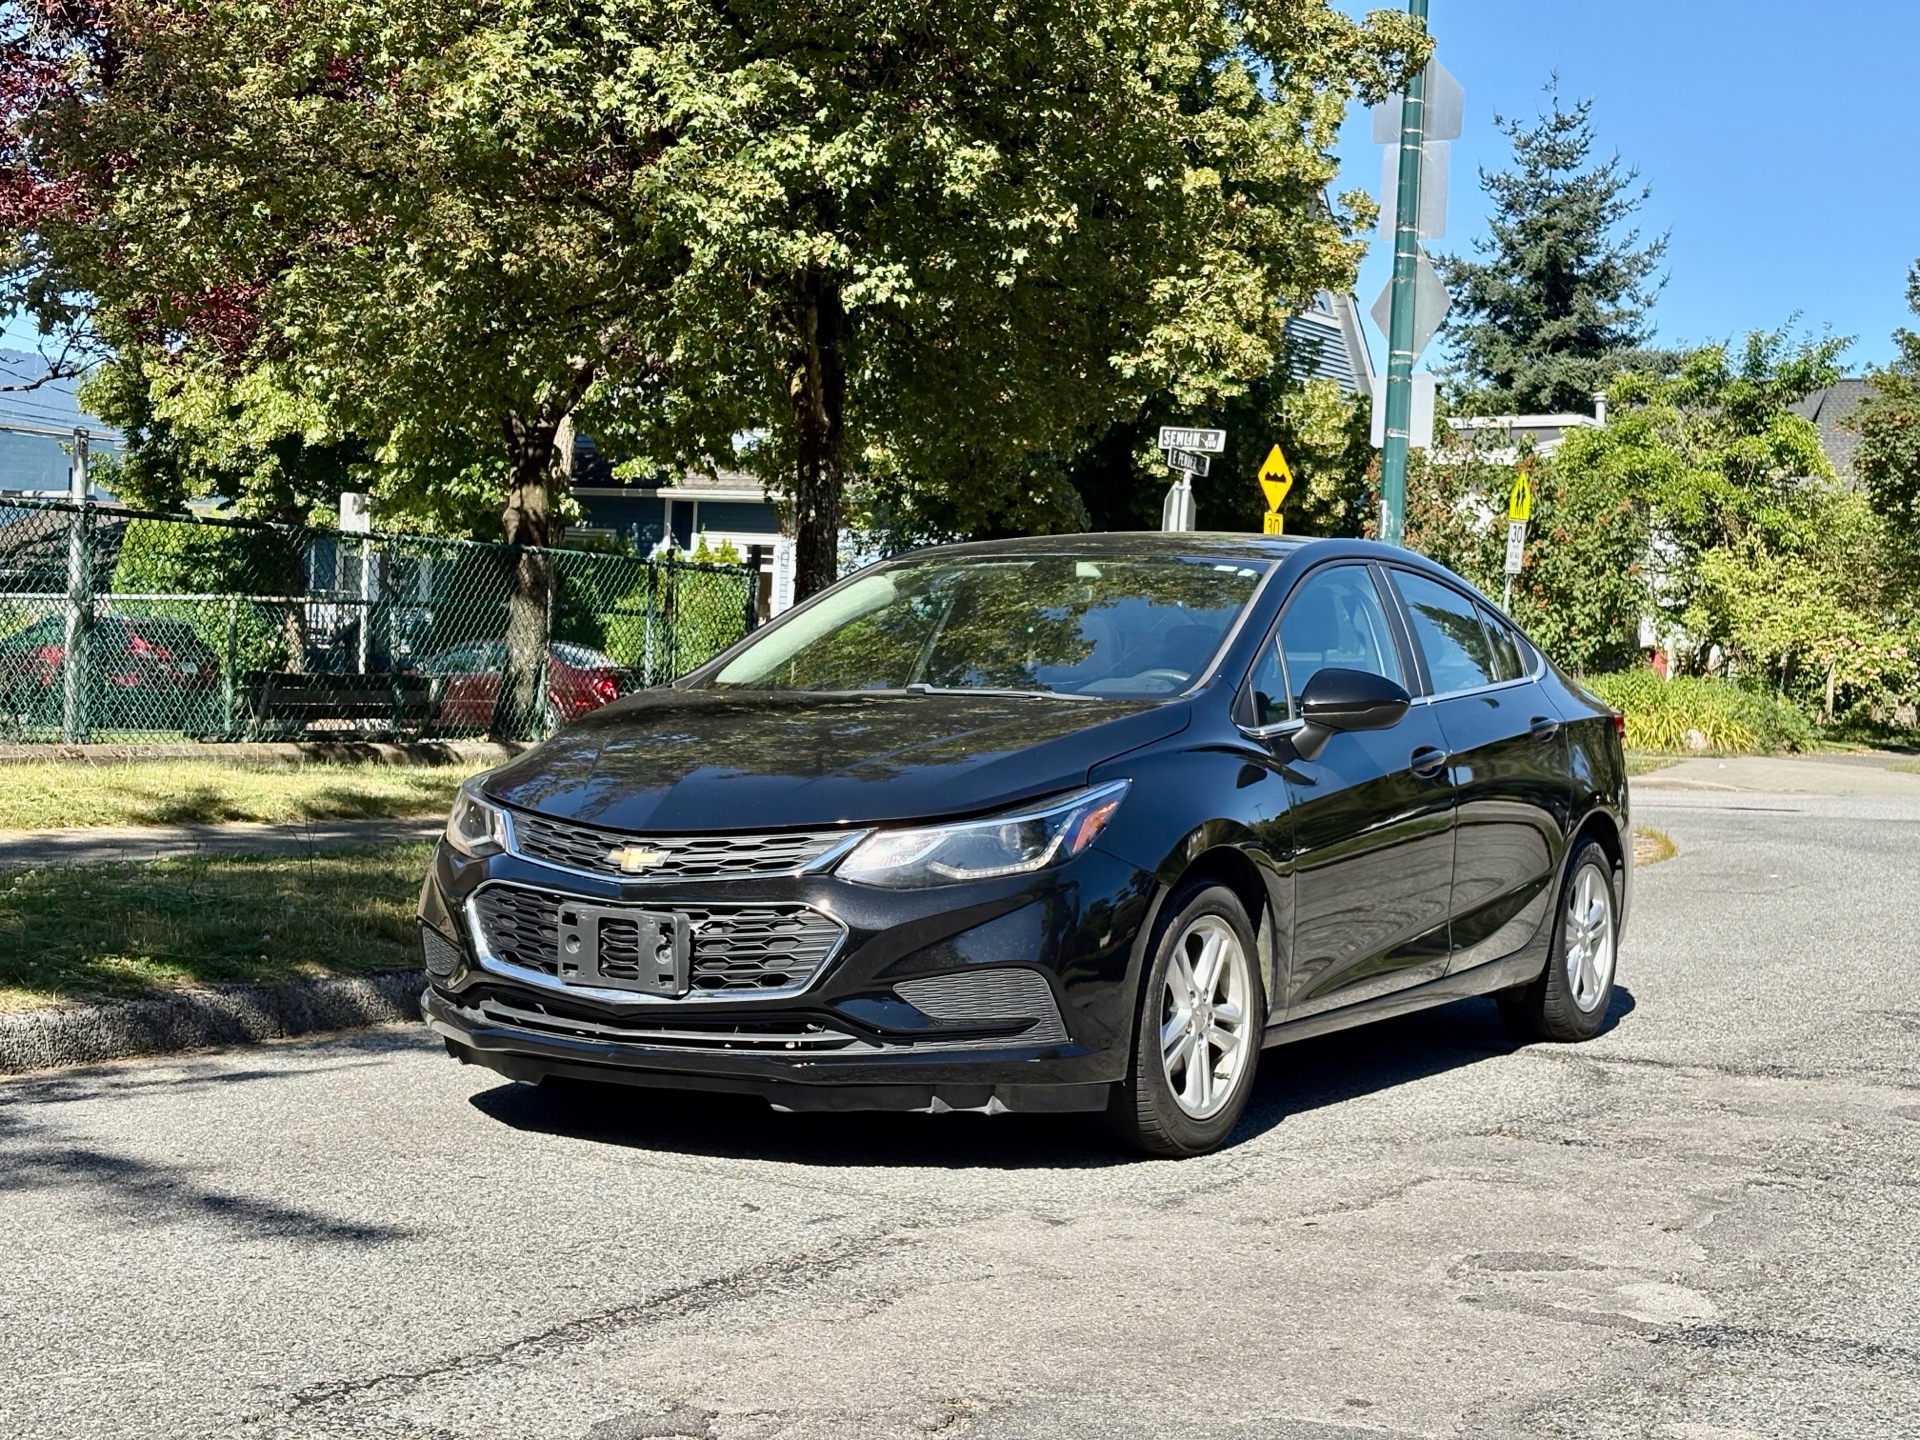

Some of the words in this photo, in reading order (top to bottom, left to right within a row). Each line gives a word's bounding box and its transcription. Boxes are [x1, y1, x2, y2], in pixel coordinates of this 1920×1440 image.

[1163, 430, 1200, 447] SEMLIN
[1172, 450, 1178, 465] E
[1268, 518, 1280, 535] 30
[1511, 525, 1523, 543] 30
